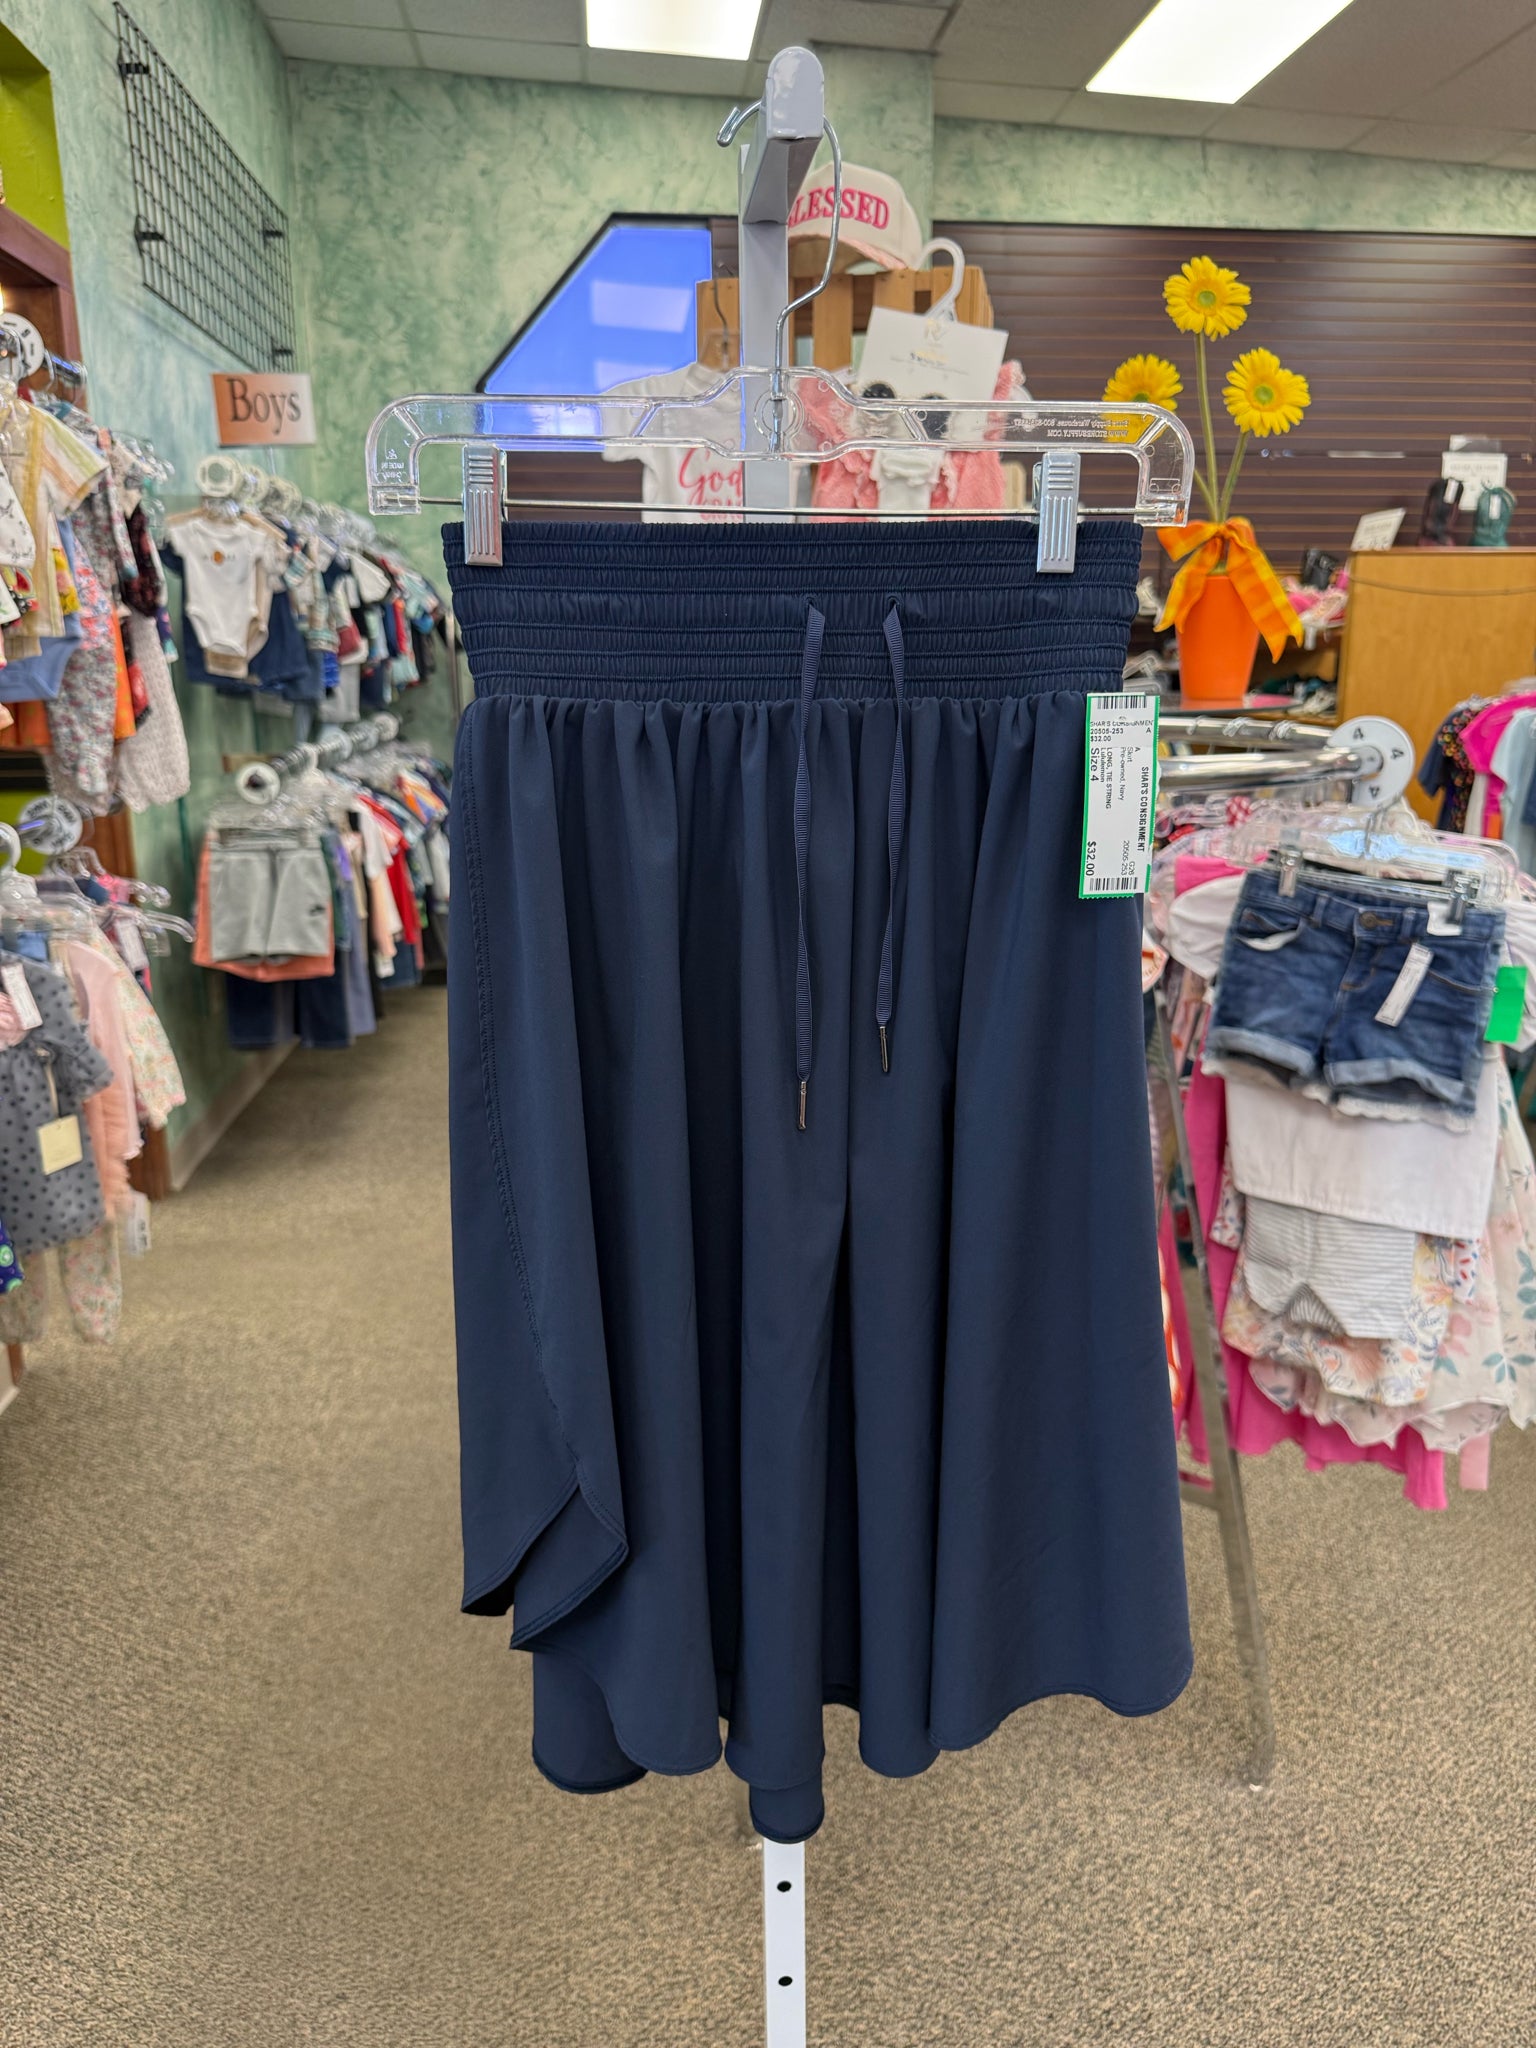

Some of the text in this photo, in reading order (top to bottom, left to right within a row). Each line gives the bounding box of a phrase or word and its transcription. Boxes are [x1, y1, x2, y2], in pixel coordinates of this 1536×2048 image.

[788, 186, 890, 230] LESSED
[226, 377, 302, 436] Boys
[1091, 747, 1100, 772] Size
[1137, 766, 1149, 852] SHAR'S CONSIGNMENT
[1085, 841, 1096, 876] $32.00
